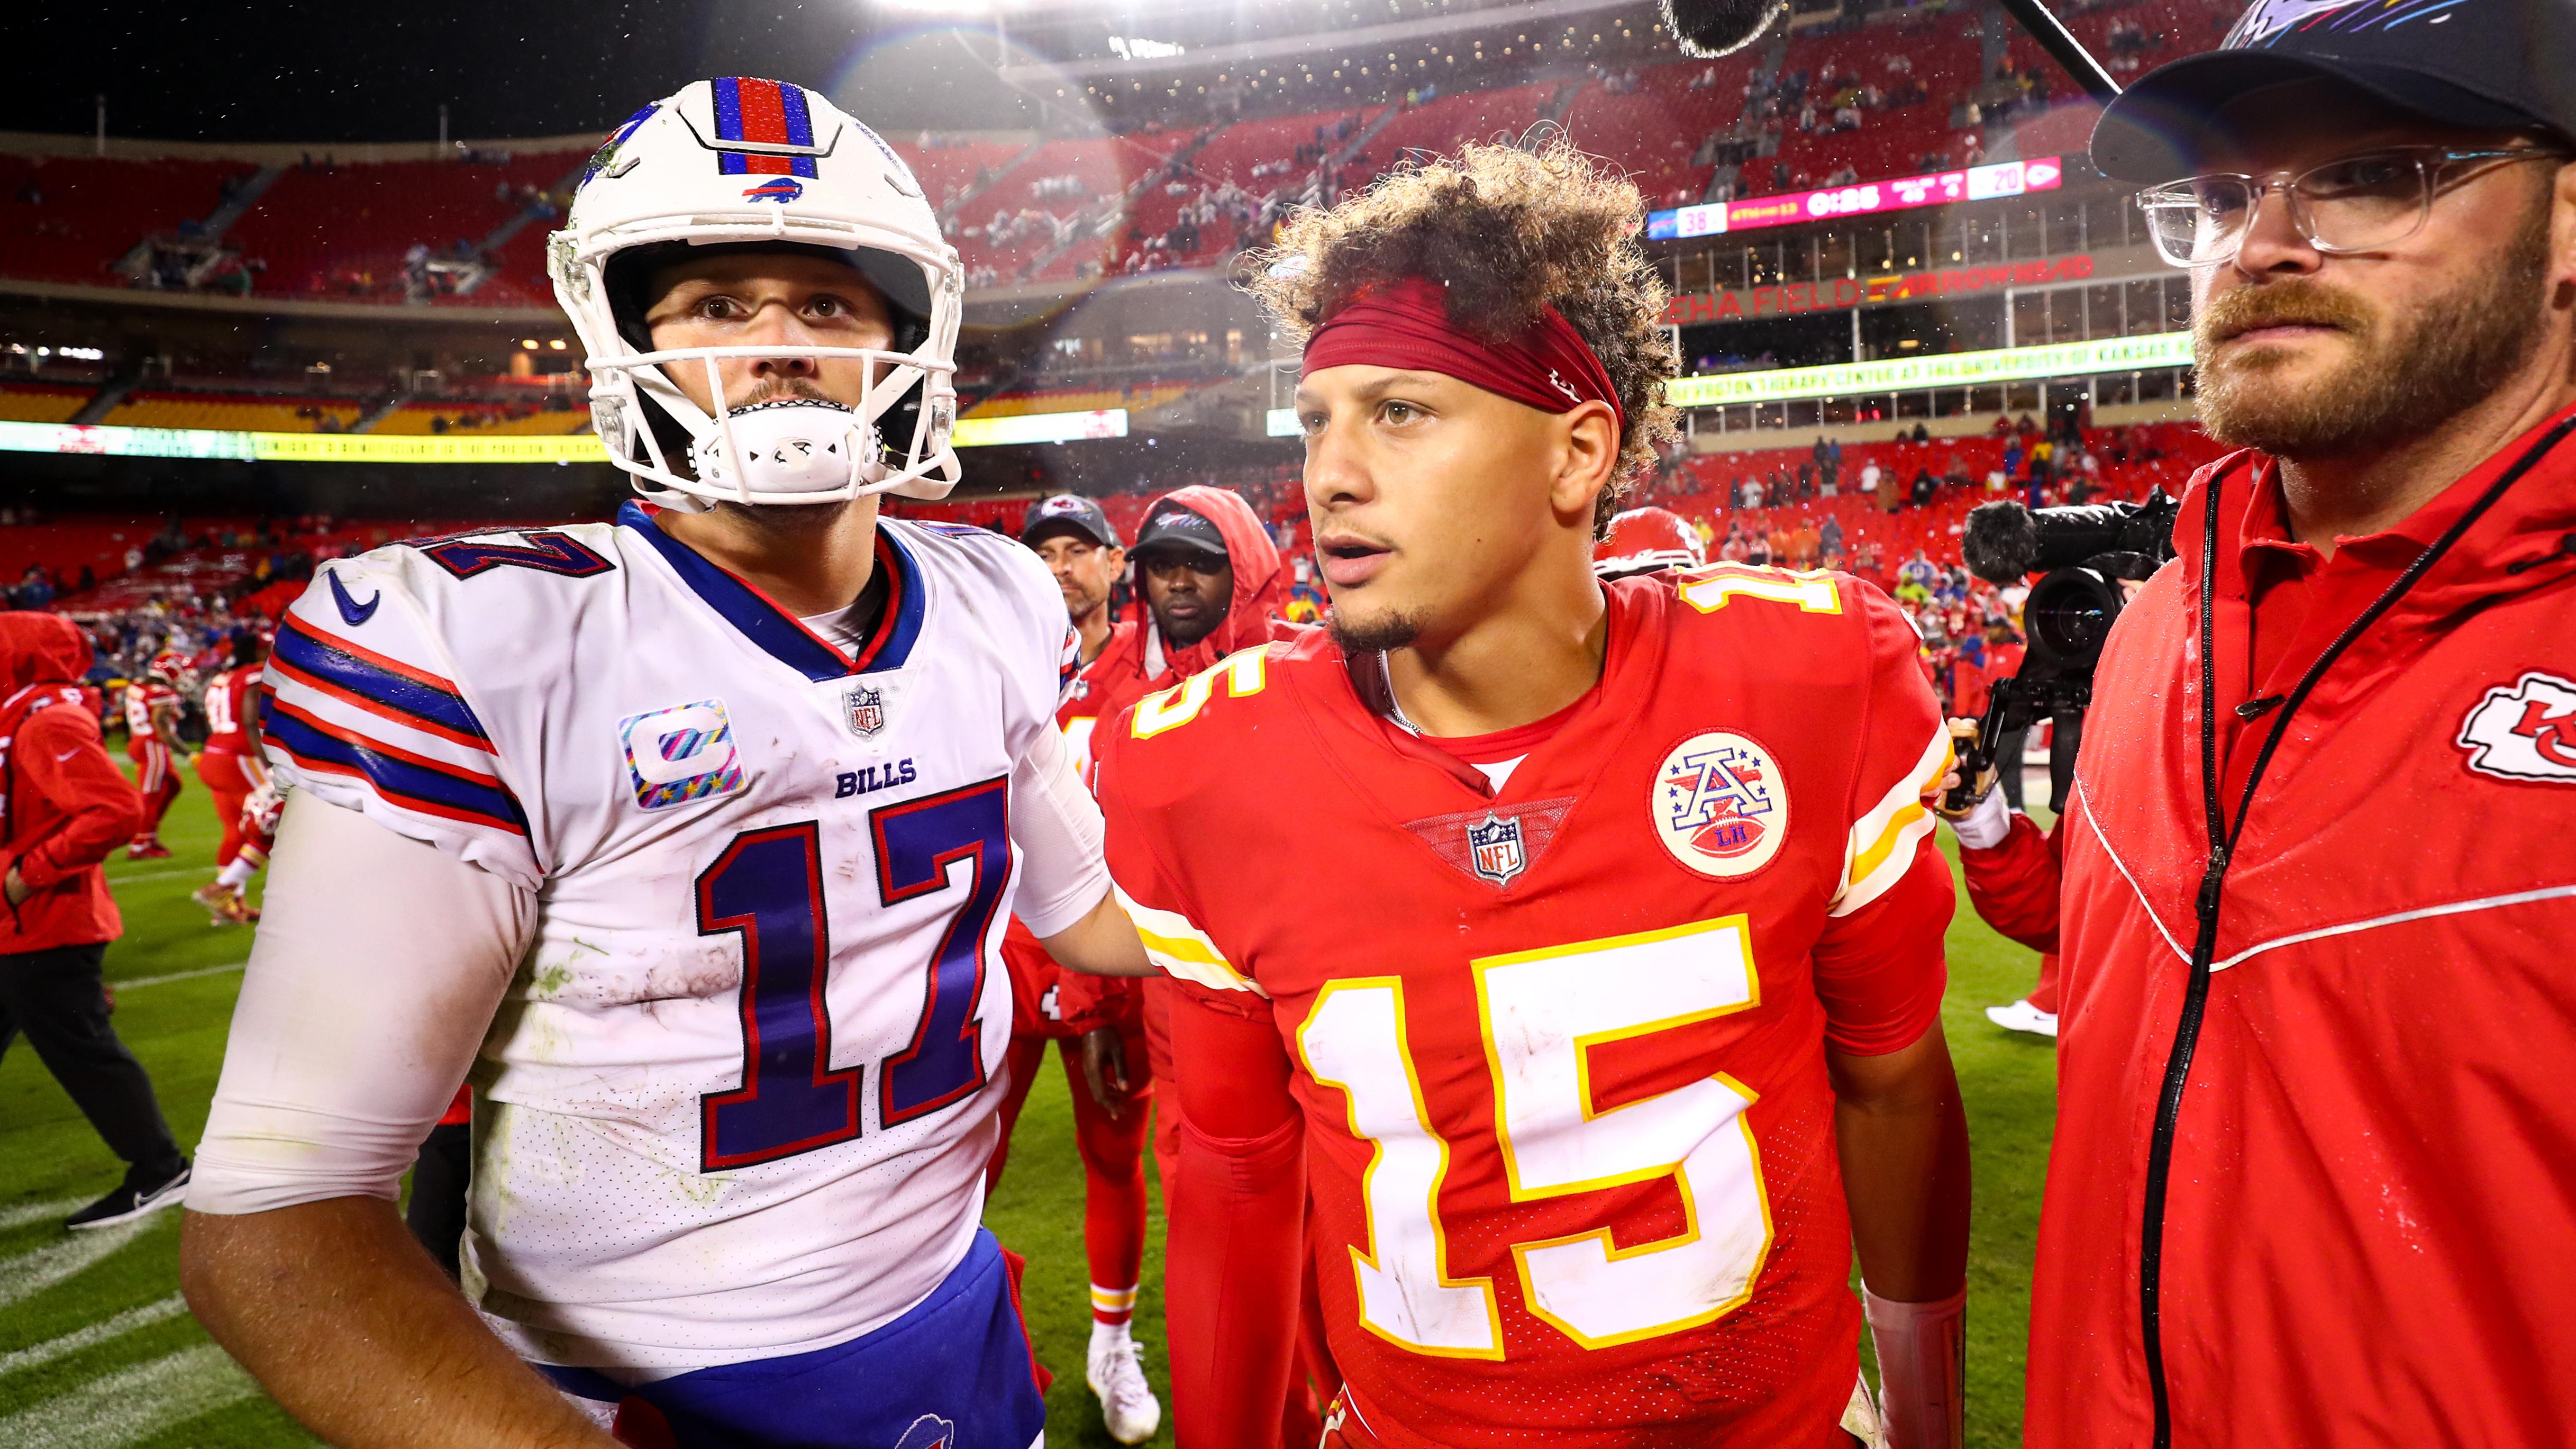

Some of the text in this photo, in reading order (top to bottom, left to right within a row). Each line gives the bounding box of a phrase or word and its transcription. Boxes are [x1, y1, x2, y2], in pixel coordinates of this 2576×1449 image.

[1995, 168, 2018, 191] 20
[1685, 211, 1707, 233] 38
[1657, 291, 1743, 325] EHA
[1753, 278, 1861, 316] FIELD
[1891, 255, 2093, 300] ARROWHEAD
[1695, 379, 1754, 399] PROTON
[1760, 371, 1829, 393] THERAPY
[1836, 366, 1895, 387] CENTER
[1963, 351, 2063, 376] UNIVERSITY
[2099, 340, 2170, 364] KANSAS
[853, 707, 881, 730] NFL
[834, 757, 917, 799] BILLS
[1714, 824, 1747, 847] LH
[1479, 843, 1517, 872] NFL
[694, 773, 1014, 1174] 17
[1295, 912, 1775, 1363] 15
